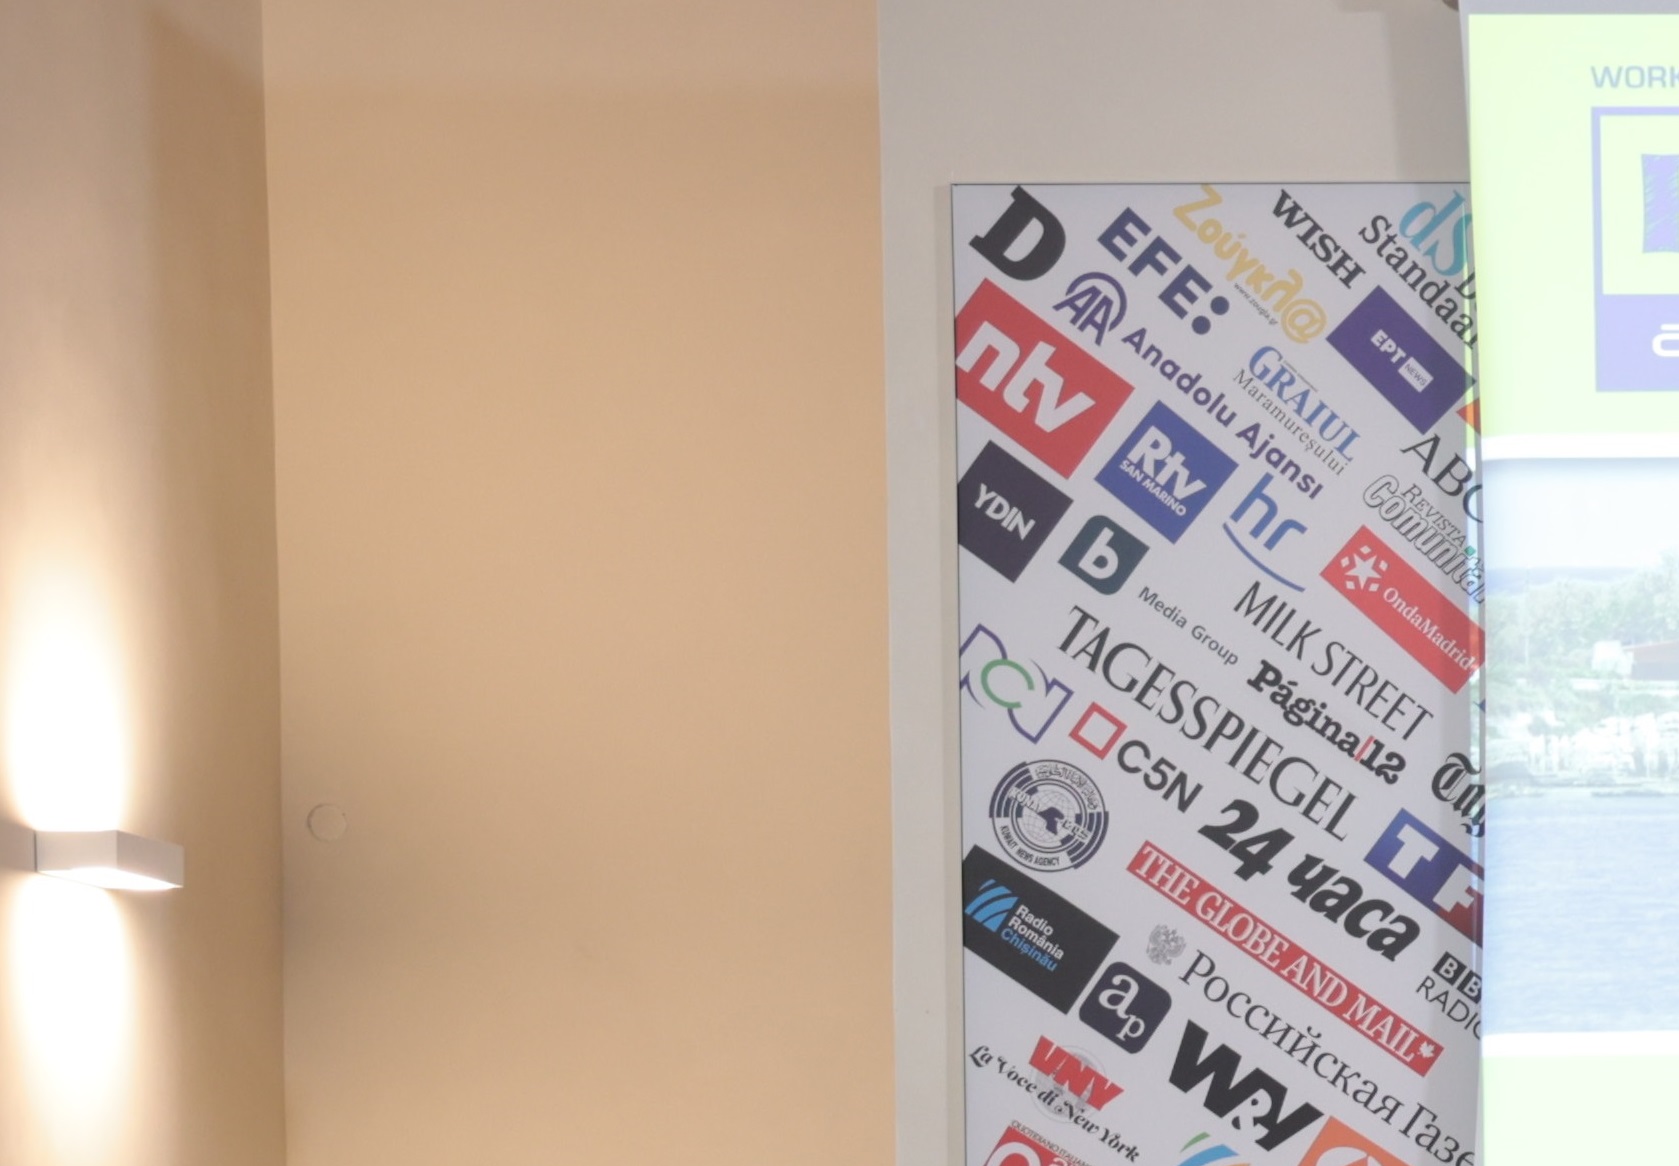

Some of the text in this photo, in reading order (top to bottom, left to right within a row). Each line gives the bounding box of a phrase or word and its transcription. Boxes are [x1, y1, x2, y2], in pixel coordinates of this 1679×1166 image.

[1271, 189, 1367, 291] WISH
[1121, 326, 1240, 430] Anadolu
[1248, 344, 1363, 464] GRAIUL
[1138, 585, 1240, 666] Media Group
[1232, 580, 1435, 742] MILK STREET
[1056, 604, 1361, 842] TAGESSPIEGEL
[1116, 739, 1203, 814] C5N
[1197, 798, 1296, 882] 24
